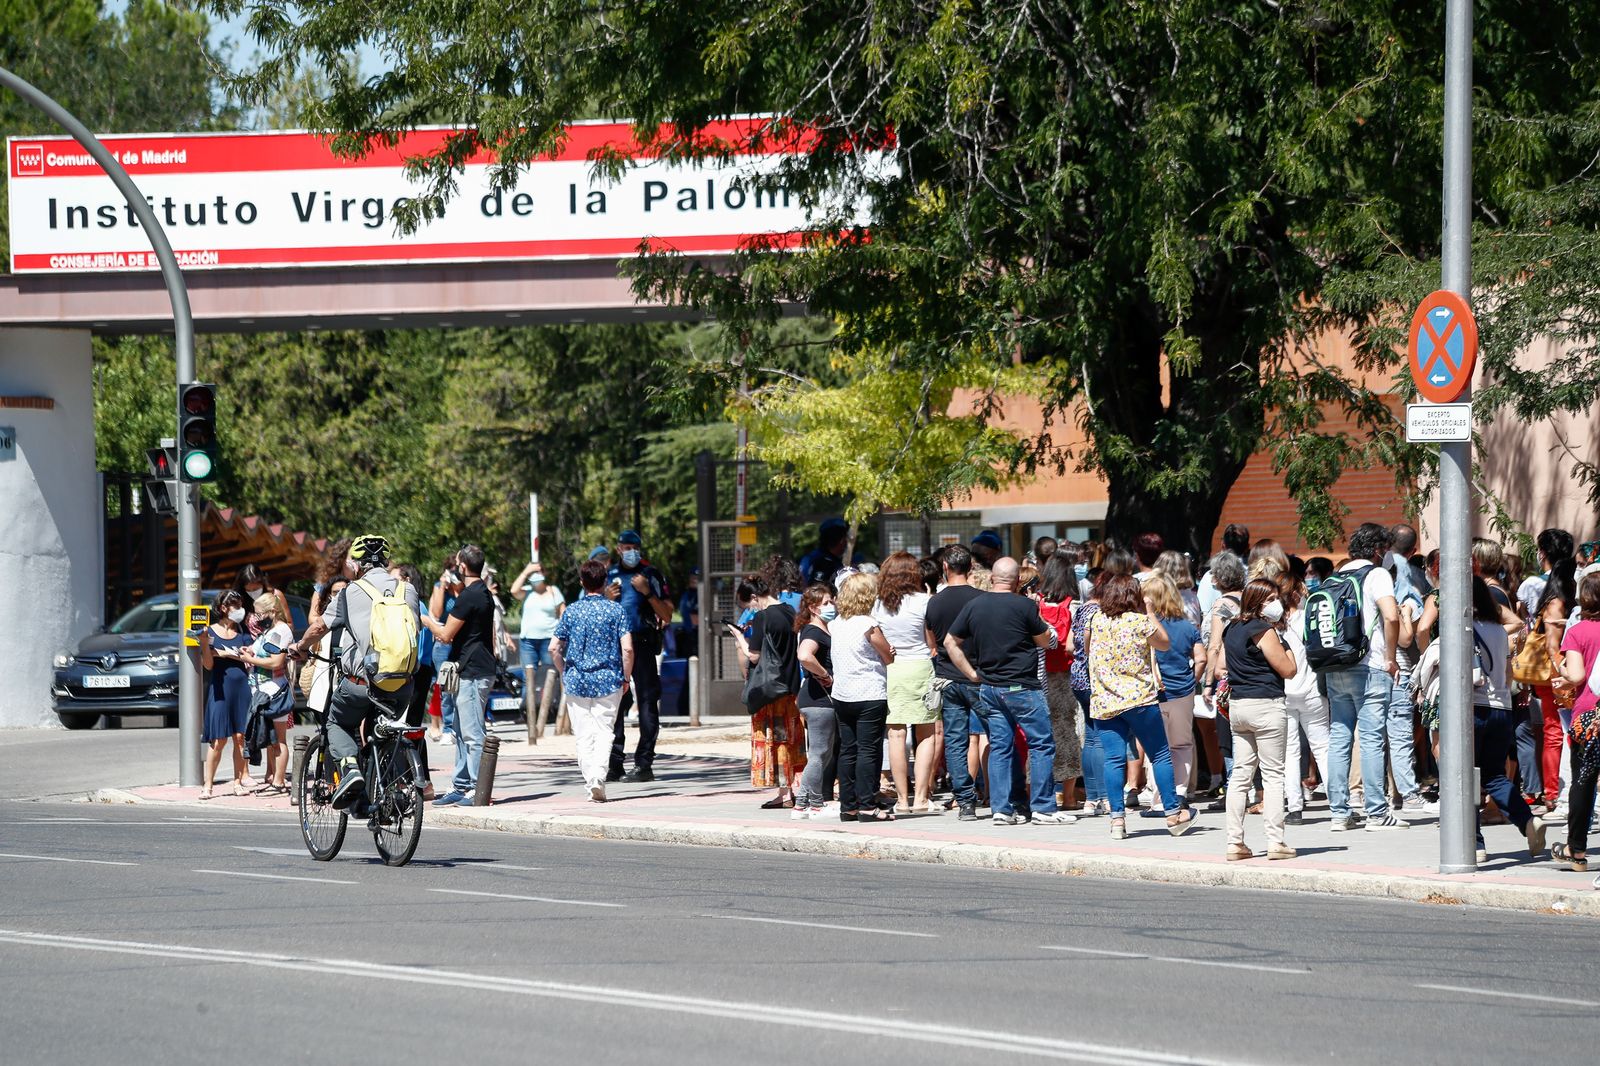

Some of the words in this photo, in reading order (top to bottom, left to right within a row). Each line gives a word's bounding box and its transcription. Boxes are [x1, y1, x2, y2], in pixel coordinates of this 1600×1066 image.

[122, 151, 138, 165] de
[141, 150, 187, 165] Madrid
[480, 185, 534, 217] de
[569, 183, 607, 214] la
[643, 178, 800, 213] Palom
[49, 252, 127, 268] CONSEJERÍA
[128, 252, 146, 266] DE
[148, 250, 219, 267] ECACIÓN
[1318, 600, 1335, 649] arena
